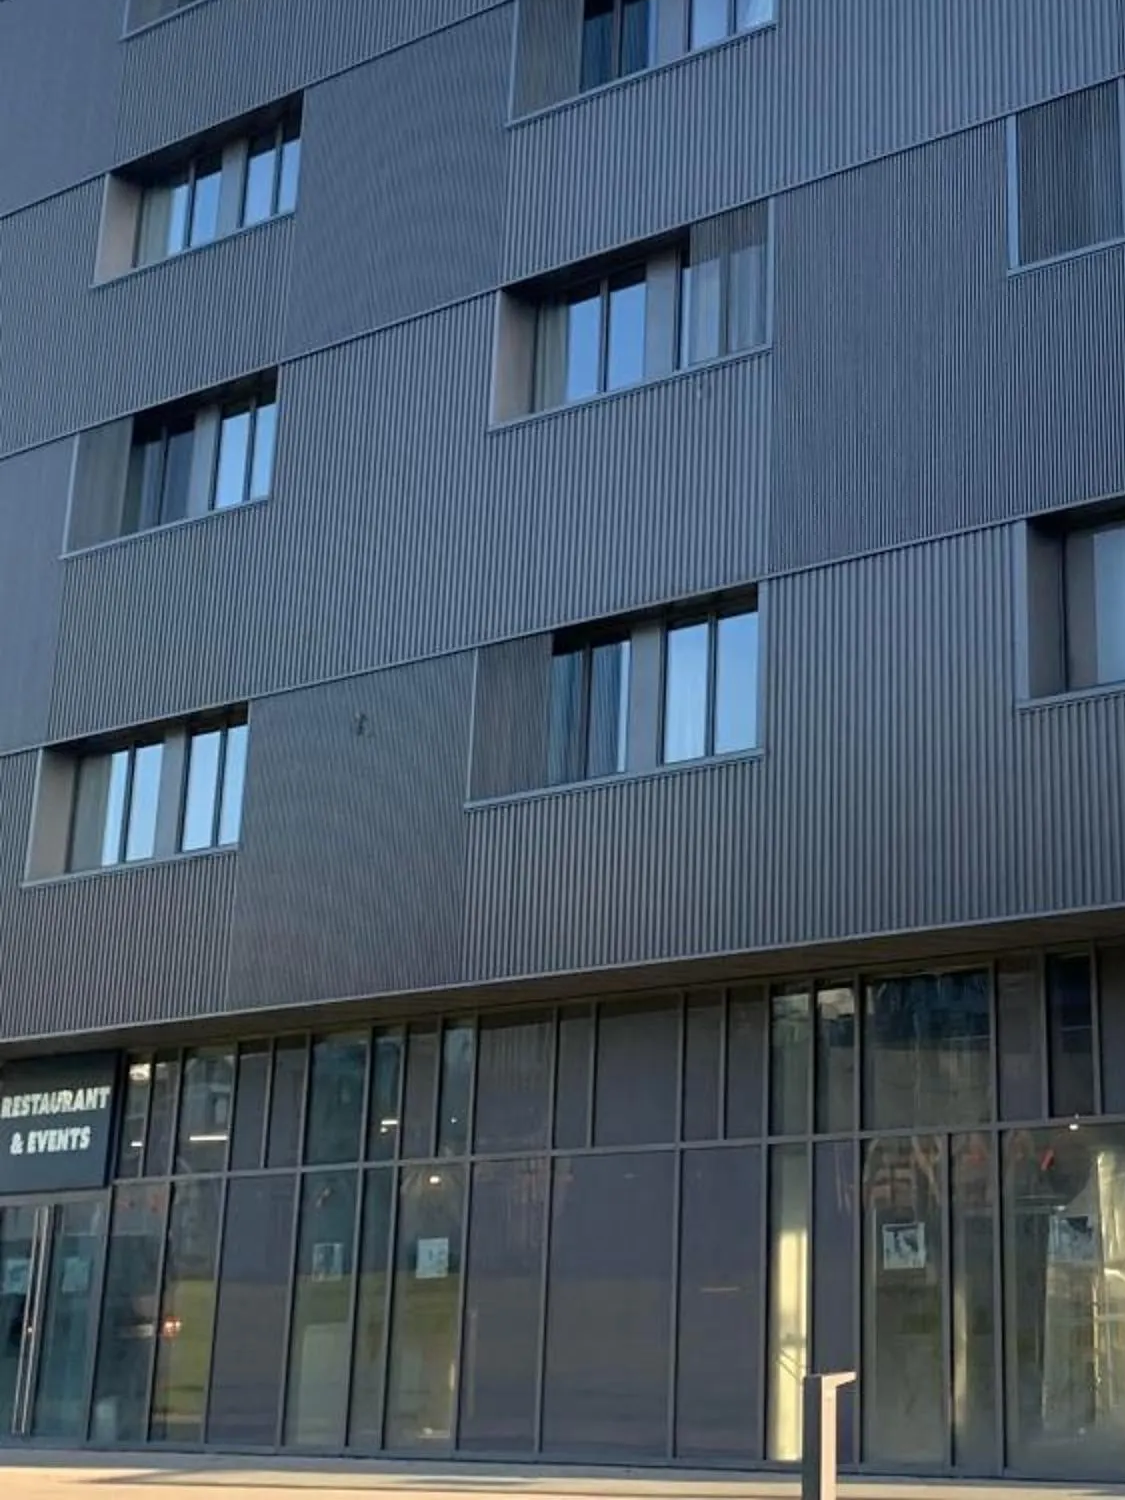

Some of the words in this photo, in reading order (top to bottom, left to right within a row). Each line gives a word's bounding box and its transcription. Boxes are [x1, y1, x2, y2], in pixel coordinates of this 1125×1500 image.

[0, 1086, 111, 1119] RESTAURANT
[10, 1131, 24, 1155] &
[26, 1126, 91, 1154] EVENTS
